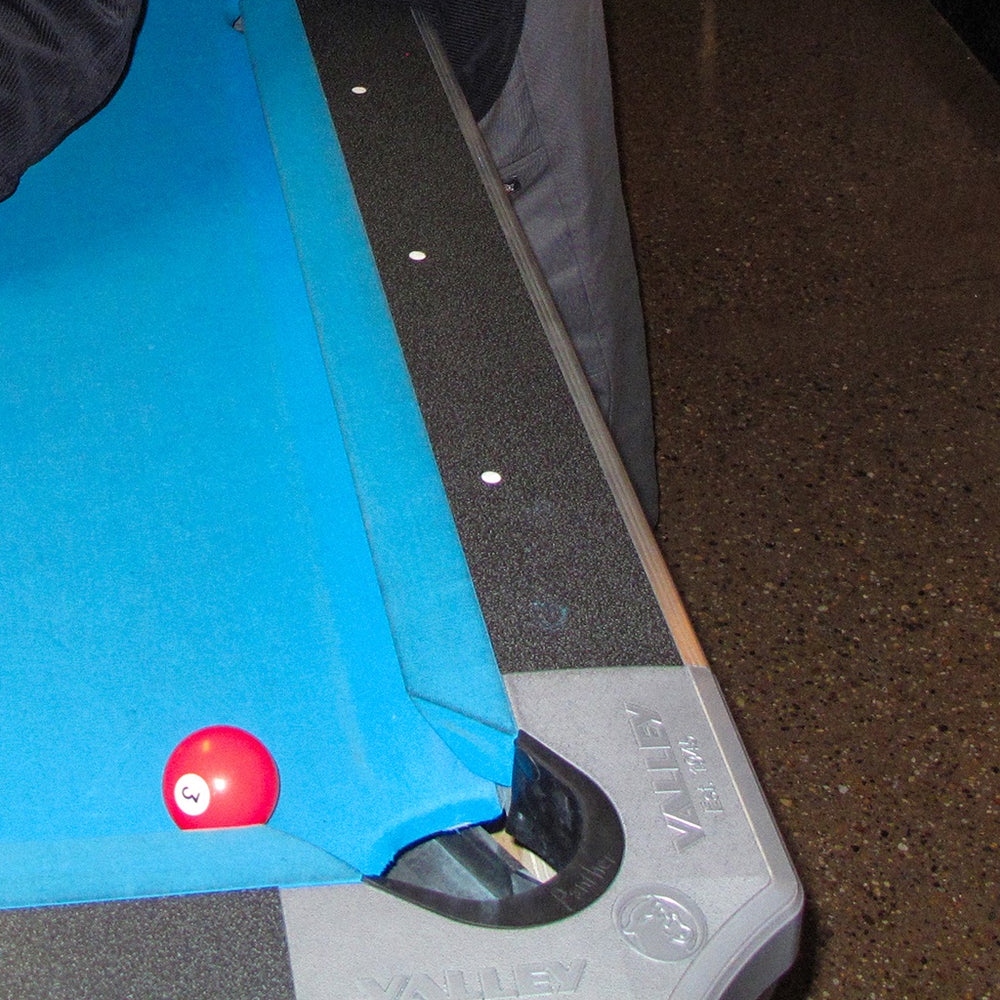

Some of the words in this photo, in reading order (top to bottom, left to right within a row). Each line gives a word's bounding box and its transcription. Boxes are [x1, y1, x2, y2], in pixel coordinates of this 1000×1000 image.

[182, 786, 200, 803] 3
[624, 701, 706, 853] VALLEY
[358, 957, 588, 1000] VALLEY
